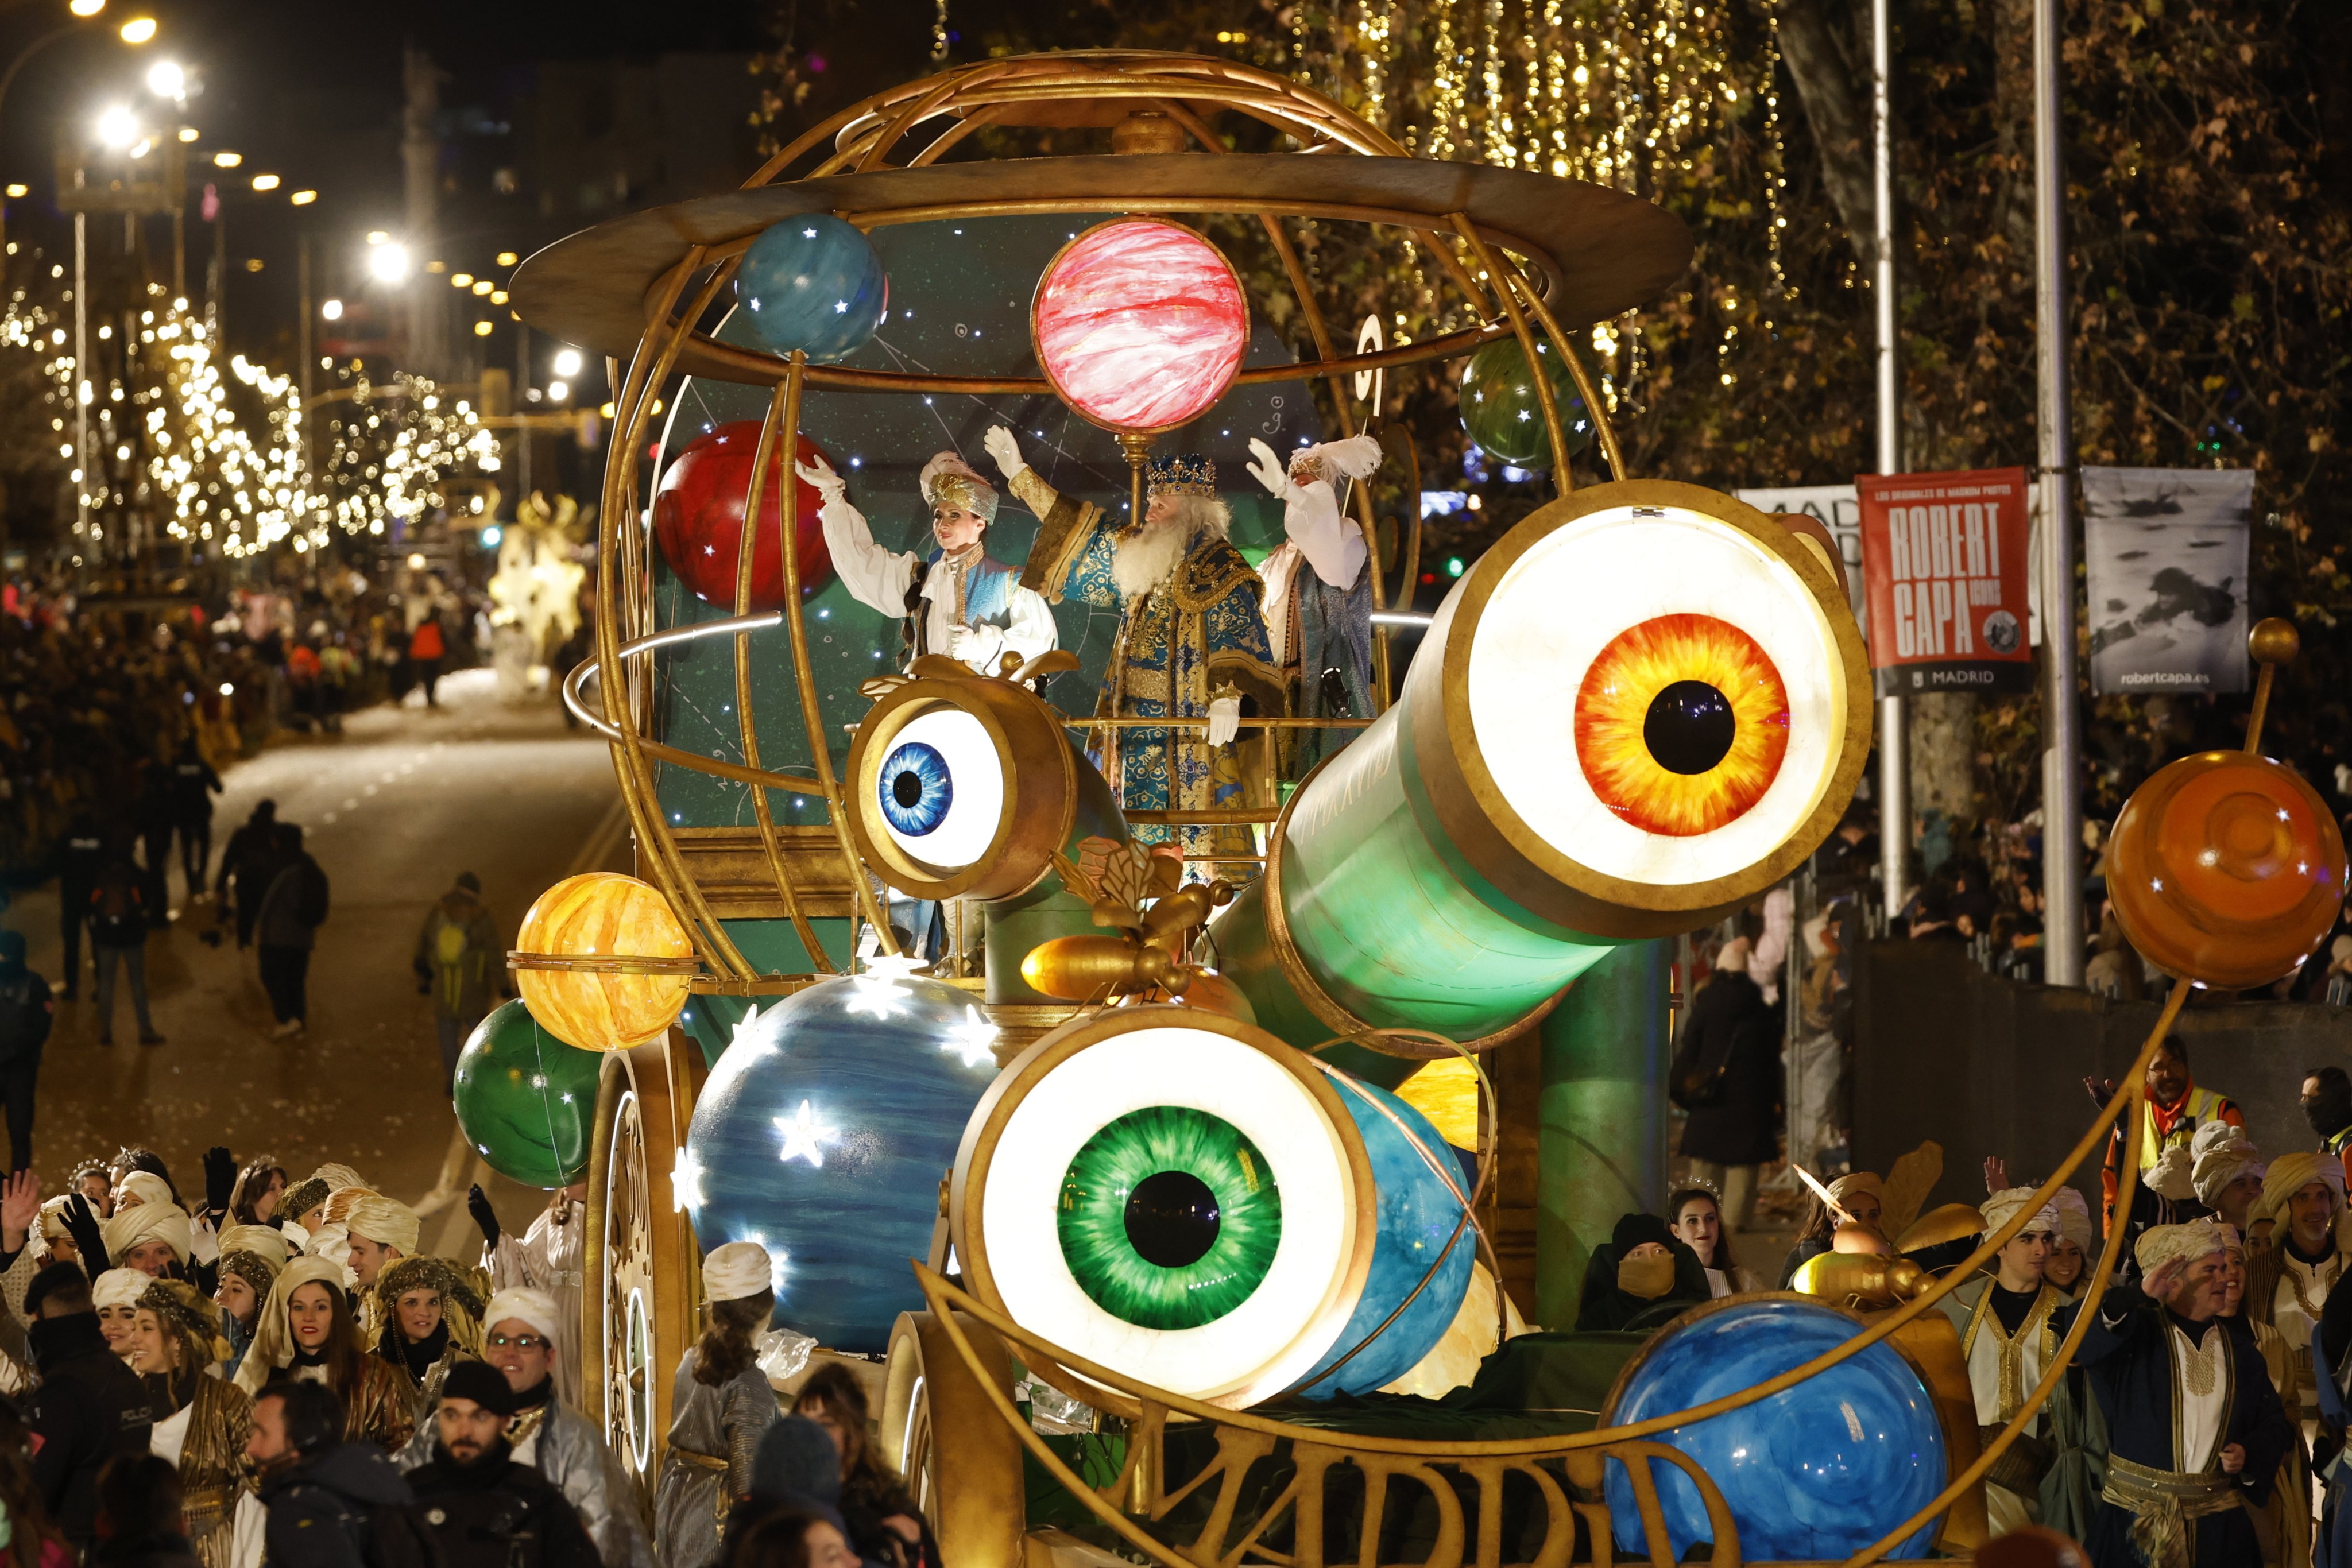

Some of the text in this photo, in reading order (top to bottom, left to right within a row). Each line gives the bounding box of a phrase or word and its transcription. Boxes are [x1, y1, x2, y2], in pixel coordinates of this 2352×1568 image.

[1889, 502, 1999, 581] ROBERT
[1893, 579, 1974, 657] CAPA
[1932, 671, 1994, 684] MADRID
[2121, 672, 2210, 684] robertcapa.es
